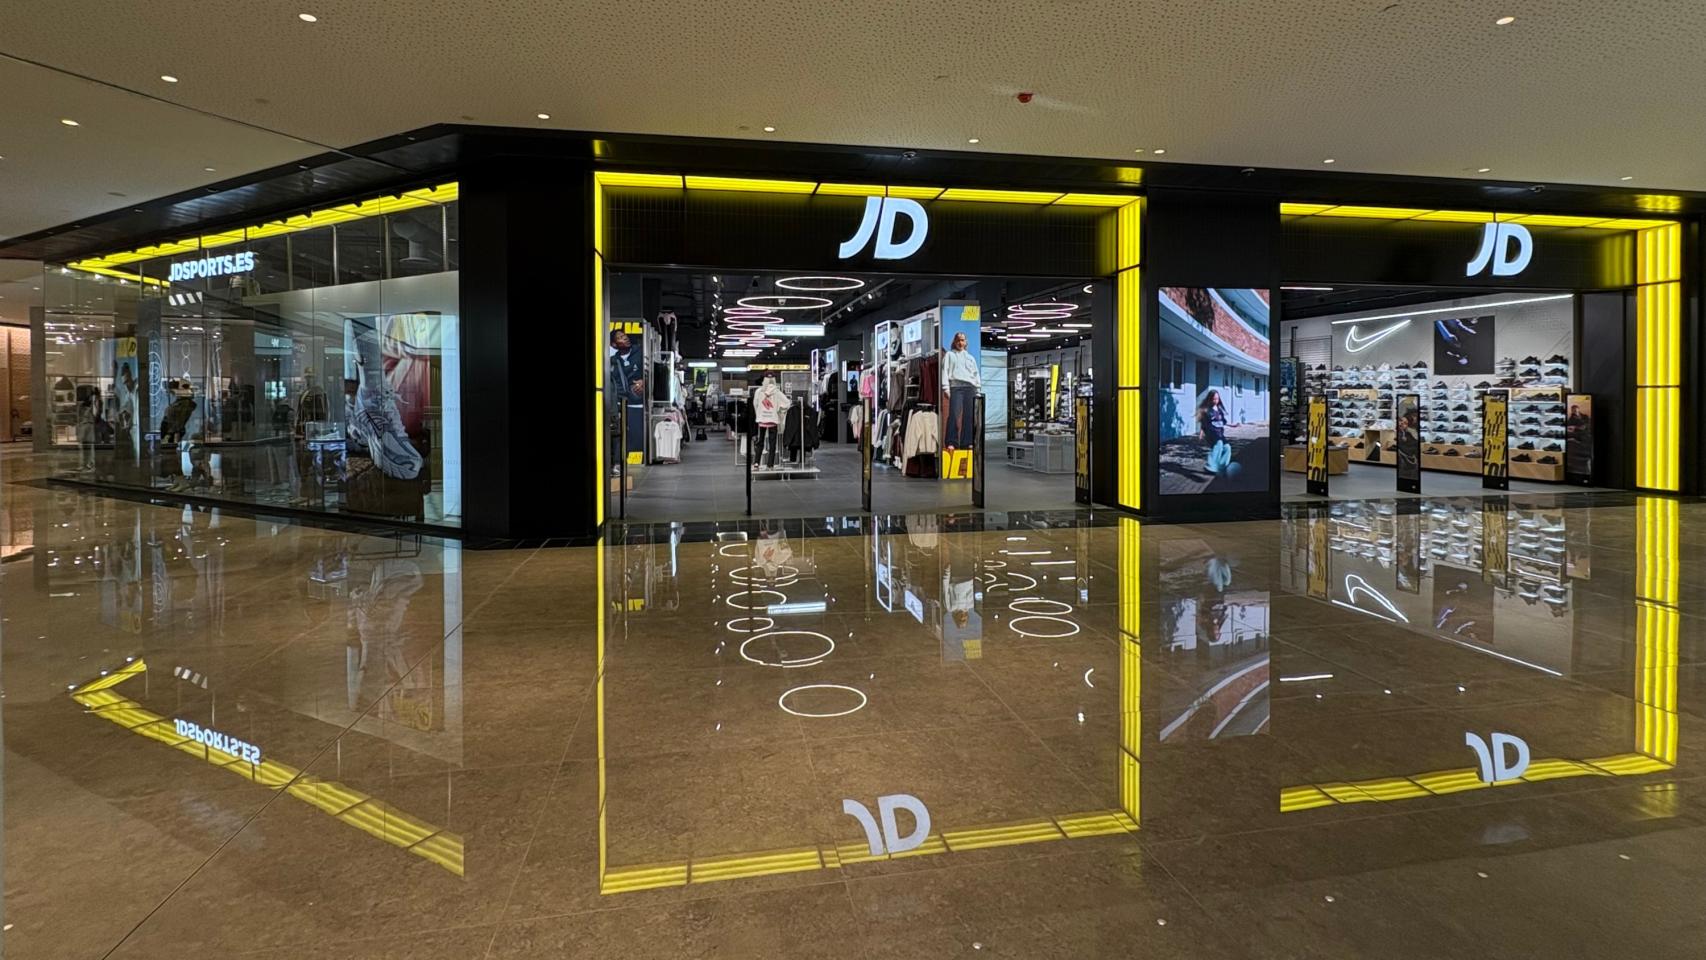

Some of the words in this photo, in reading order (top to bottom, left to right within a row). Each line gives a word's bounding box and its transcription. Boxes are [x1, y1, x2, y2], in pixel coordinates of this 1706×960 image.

[838, 196, 929, 259] JD
[1466, 222, 1533, 277] JD
[168, 251, 254, 282] JDSPORTS.ES
